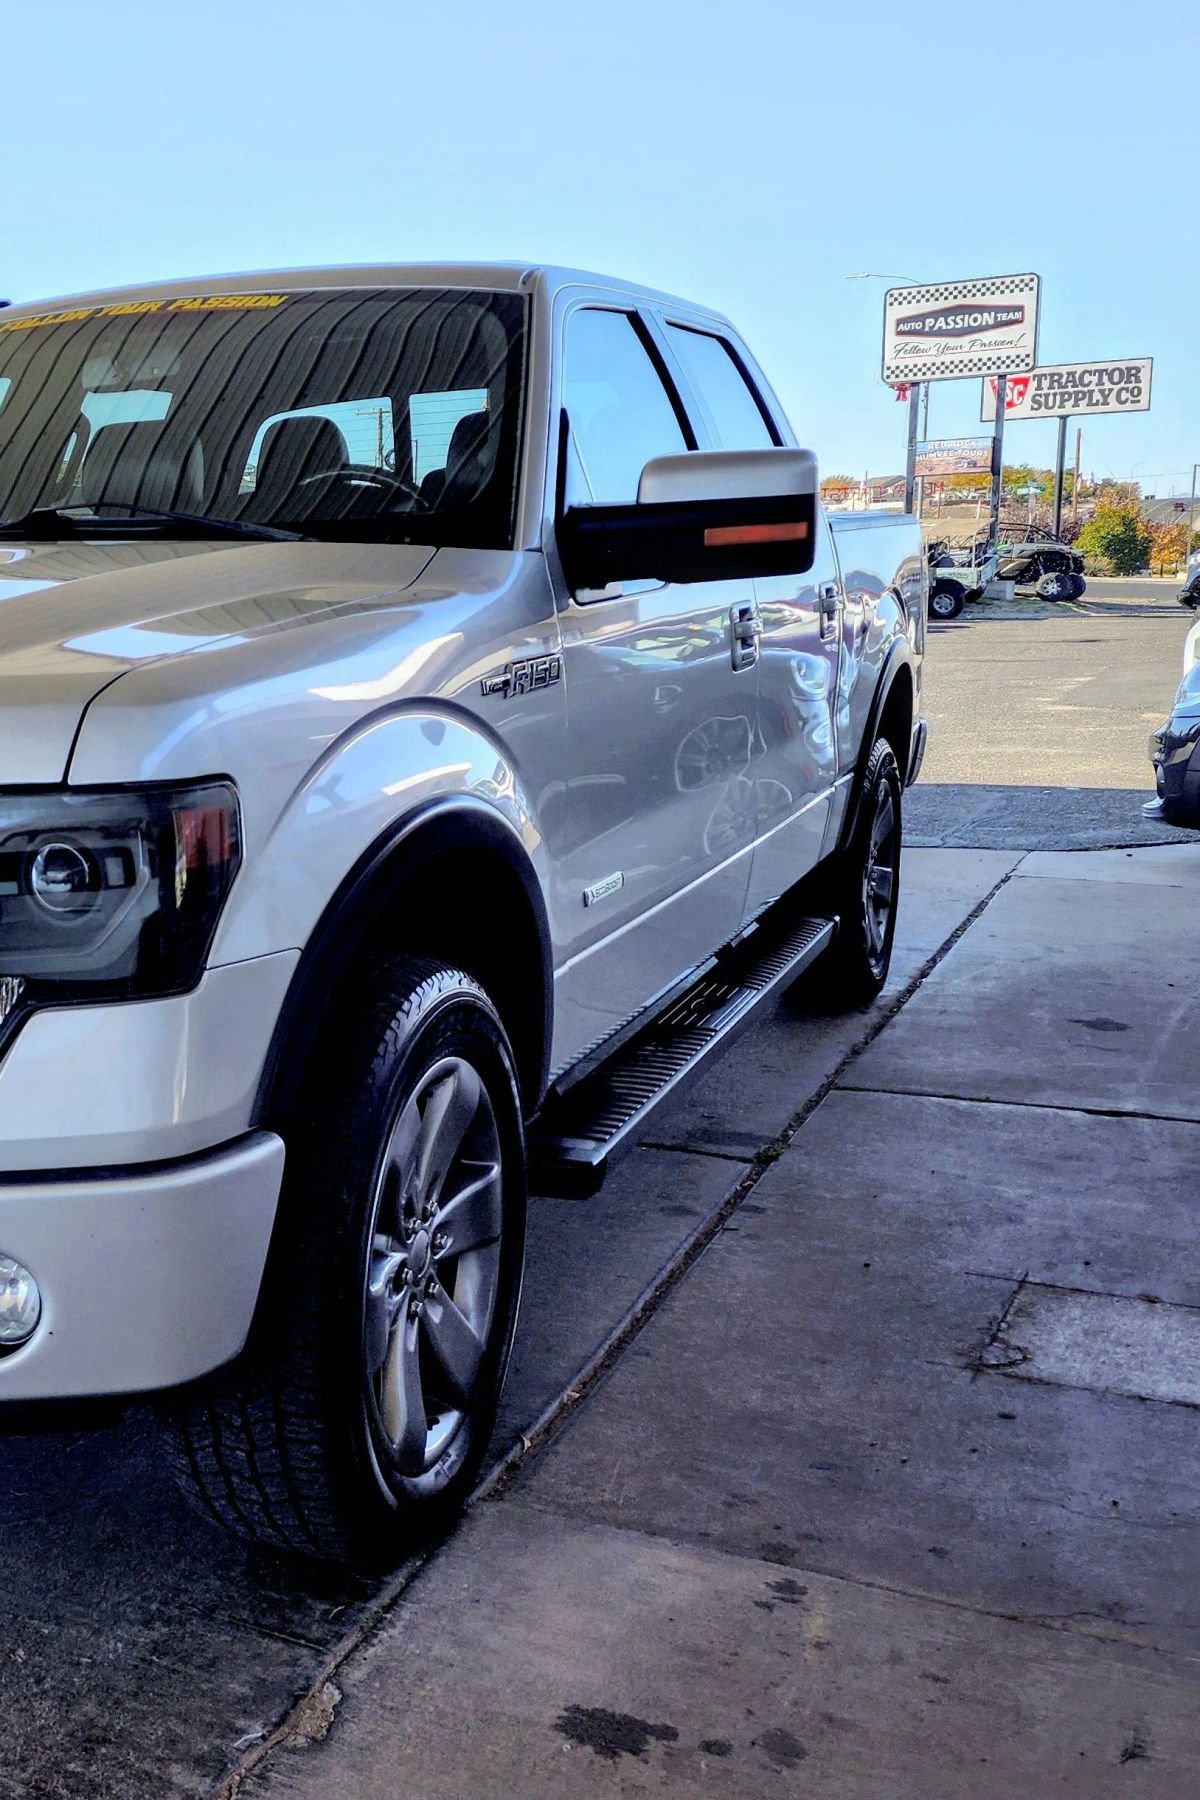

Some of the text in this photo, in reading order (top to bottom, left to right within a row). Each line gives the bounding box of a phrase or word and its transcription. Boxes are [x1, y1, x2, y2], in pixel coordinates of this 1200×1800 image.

[96, 300, 167, 317] YOUR
[167, 295, 289, 311] PASSION
[897, 311, 1023, 332] AUTO PASSION TEAM
[893, 333, 1026, 360] Follow Your Passion!
[1032, 365, 1143, 391] TRACTOR
[1030, 387, 1115, 411] SUPPLY
[915, 449, 989, 462] HUMVEE TOURS
[928, 439, 977, 450] RED ROCK
